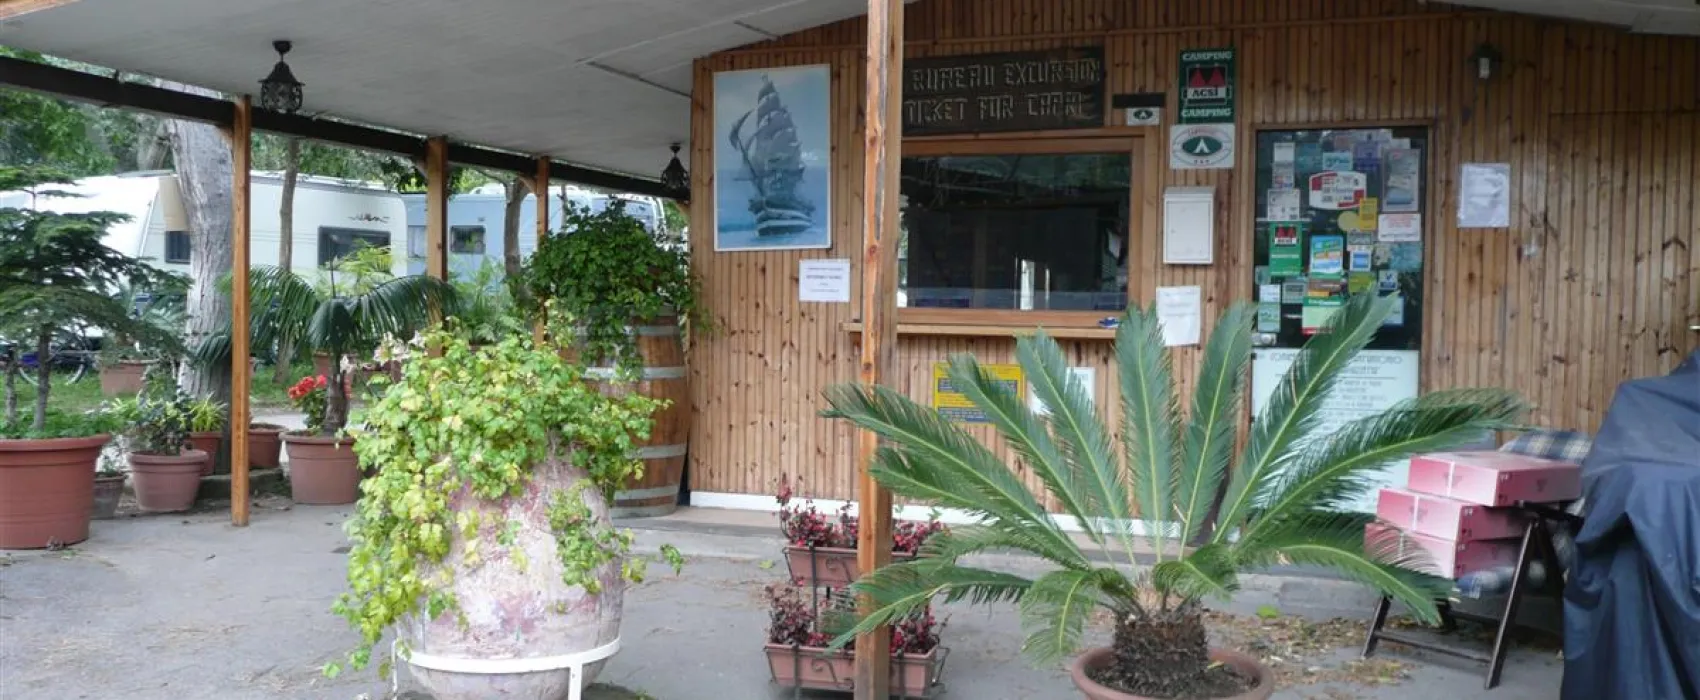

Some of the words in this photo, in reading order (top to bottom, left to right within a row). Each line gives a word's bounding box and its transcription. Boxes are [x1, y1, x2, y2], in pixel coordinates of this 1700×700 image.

[1182, 51, 1233, 62] CAMPING
[911, 65, 995, 92] BUREAU
[1003, 58, 1101, 86] EXCURSION
[1192, 87, 1219, 97] ACSI
[903, 98, 968, 126] TICKET
[976, 94, 1014, 121] FOR
[1024, 91, 1082, 117] CAPRI
[1181, 108, 1232, 118] CAMPING
